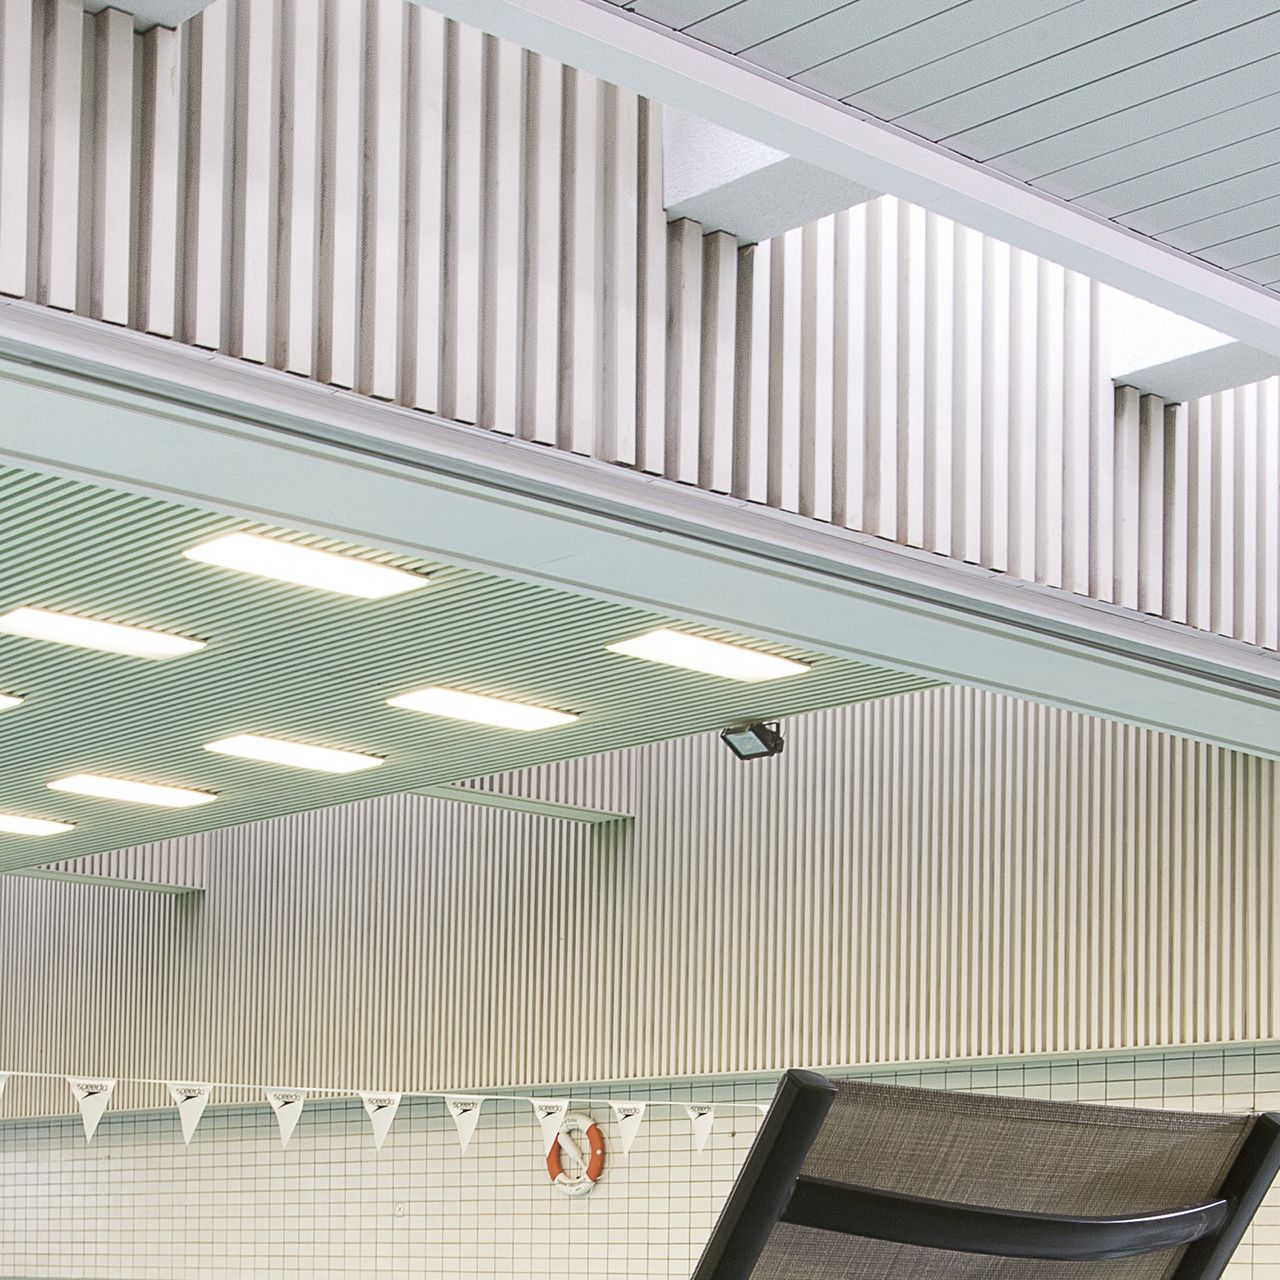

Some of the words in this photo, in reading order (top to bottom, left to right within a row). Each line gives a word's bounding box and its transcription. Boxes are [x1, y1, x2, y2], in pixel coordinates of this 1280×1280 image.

[76, 1083, 108, 1092] speedo
[176, 1087, 206, 1096] speedo
[273, 1092, 301, 1101] speedo
[368, 1097, 395, 1105] speedo
